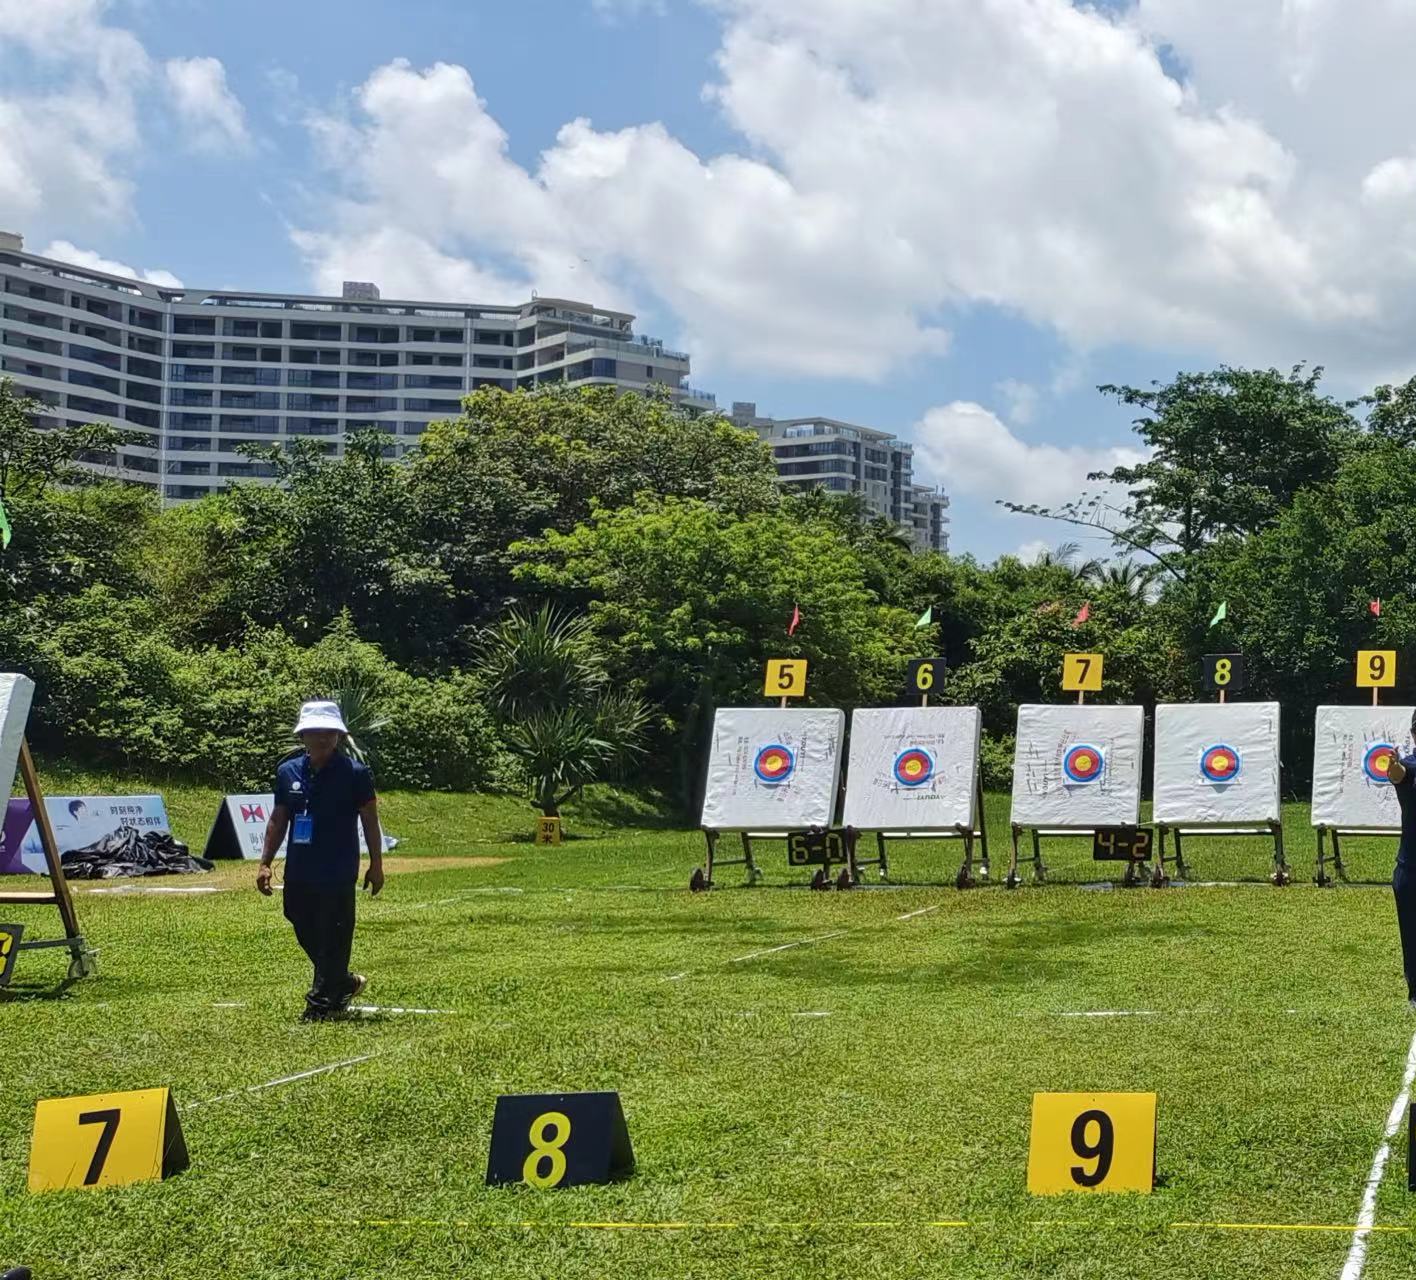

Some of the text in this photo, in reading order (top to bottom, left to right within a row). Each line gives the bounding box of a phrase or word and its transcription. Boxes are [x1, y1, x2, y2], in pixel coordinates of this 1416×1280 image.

[778, 664, 794, 690] 5
[916, 663, 933, 690] 6
[1076, 658, 1091, 684] 7
[1214, 658, 1232, 685] 8
[1369, 655, 1386, 681] 9
[542, 822, 554, 832] 30
[1098, 832, 1149, 857] 4-2
[79, 1108, 121, 1185] 7
[523, 1112, 571, 1189] 8
[1070, 1110, 1114, 1187] 9
